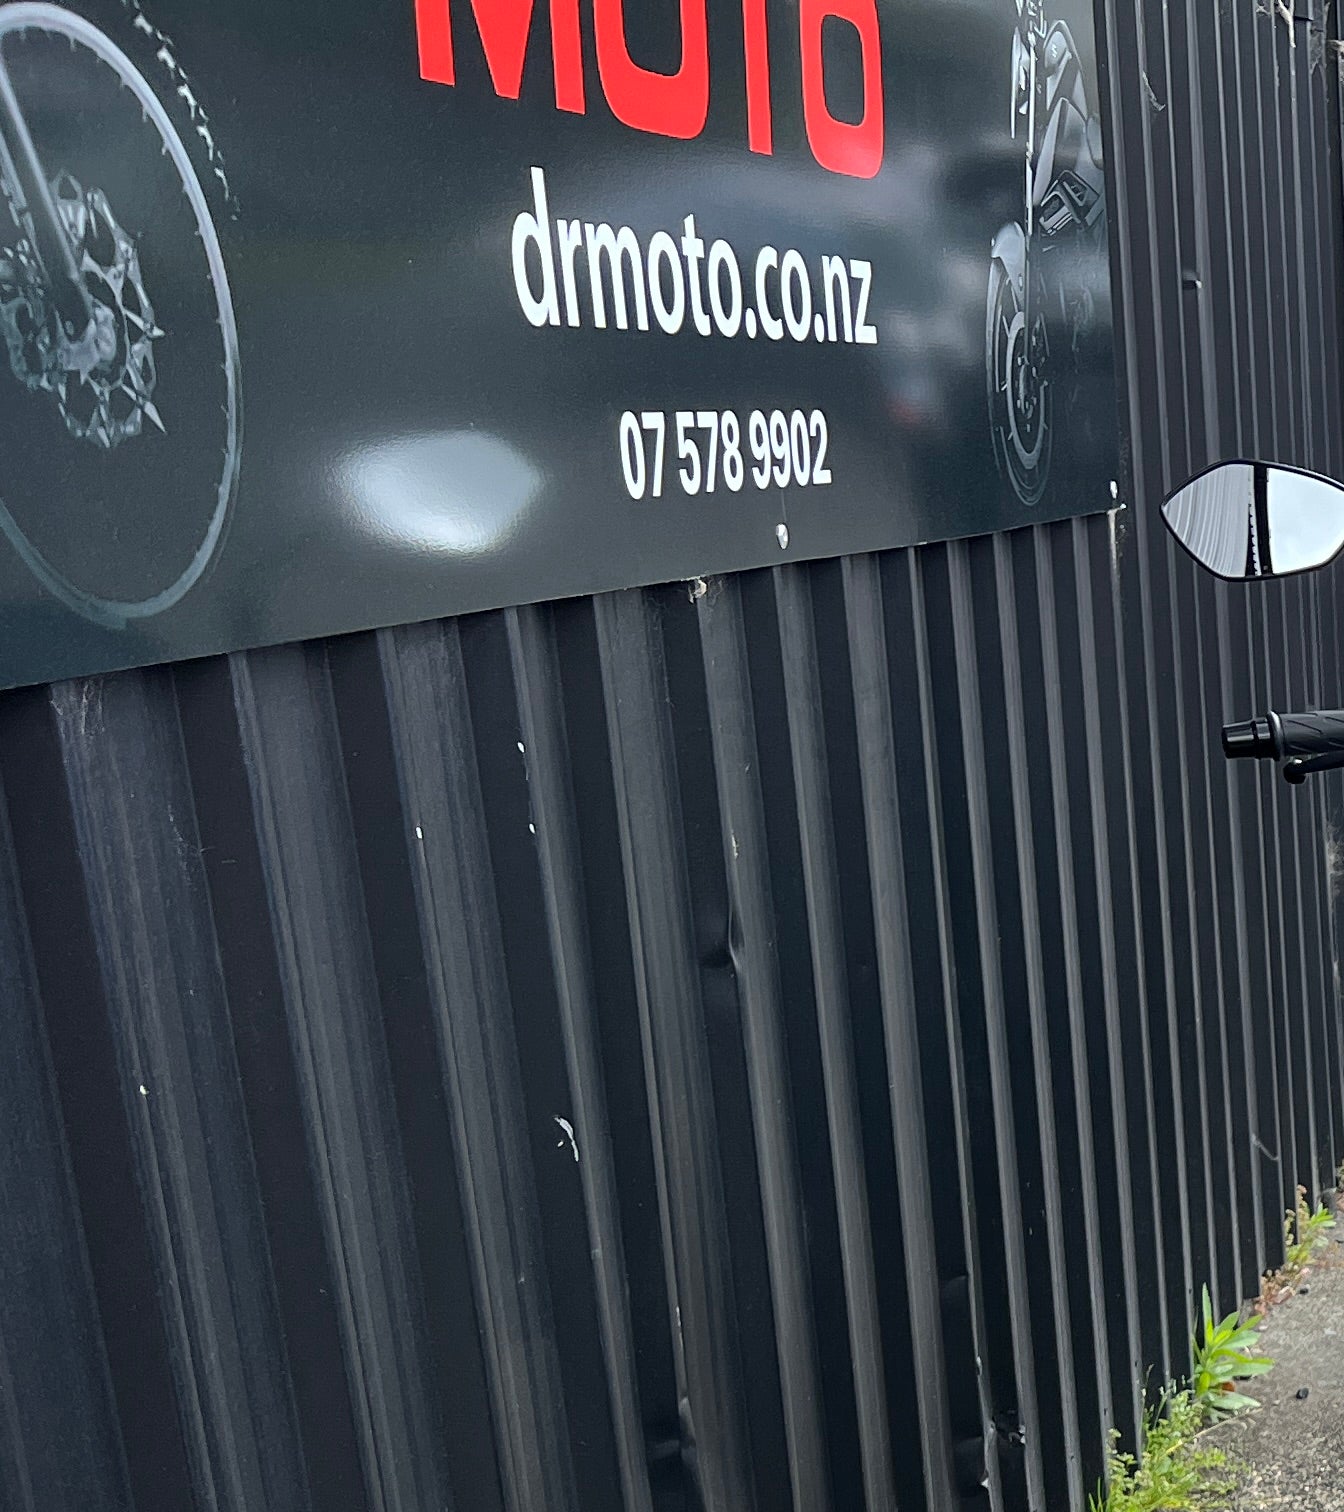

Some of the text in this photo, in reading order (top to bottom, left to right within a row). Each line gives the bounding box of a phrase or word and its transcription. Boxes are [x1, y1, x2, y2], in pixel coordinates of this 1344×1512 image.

[511, 165, 878, 344] drmoto.co.nz
[619, 408, 832, 500] 07 578 9902
